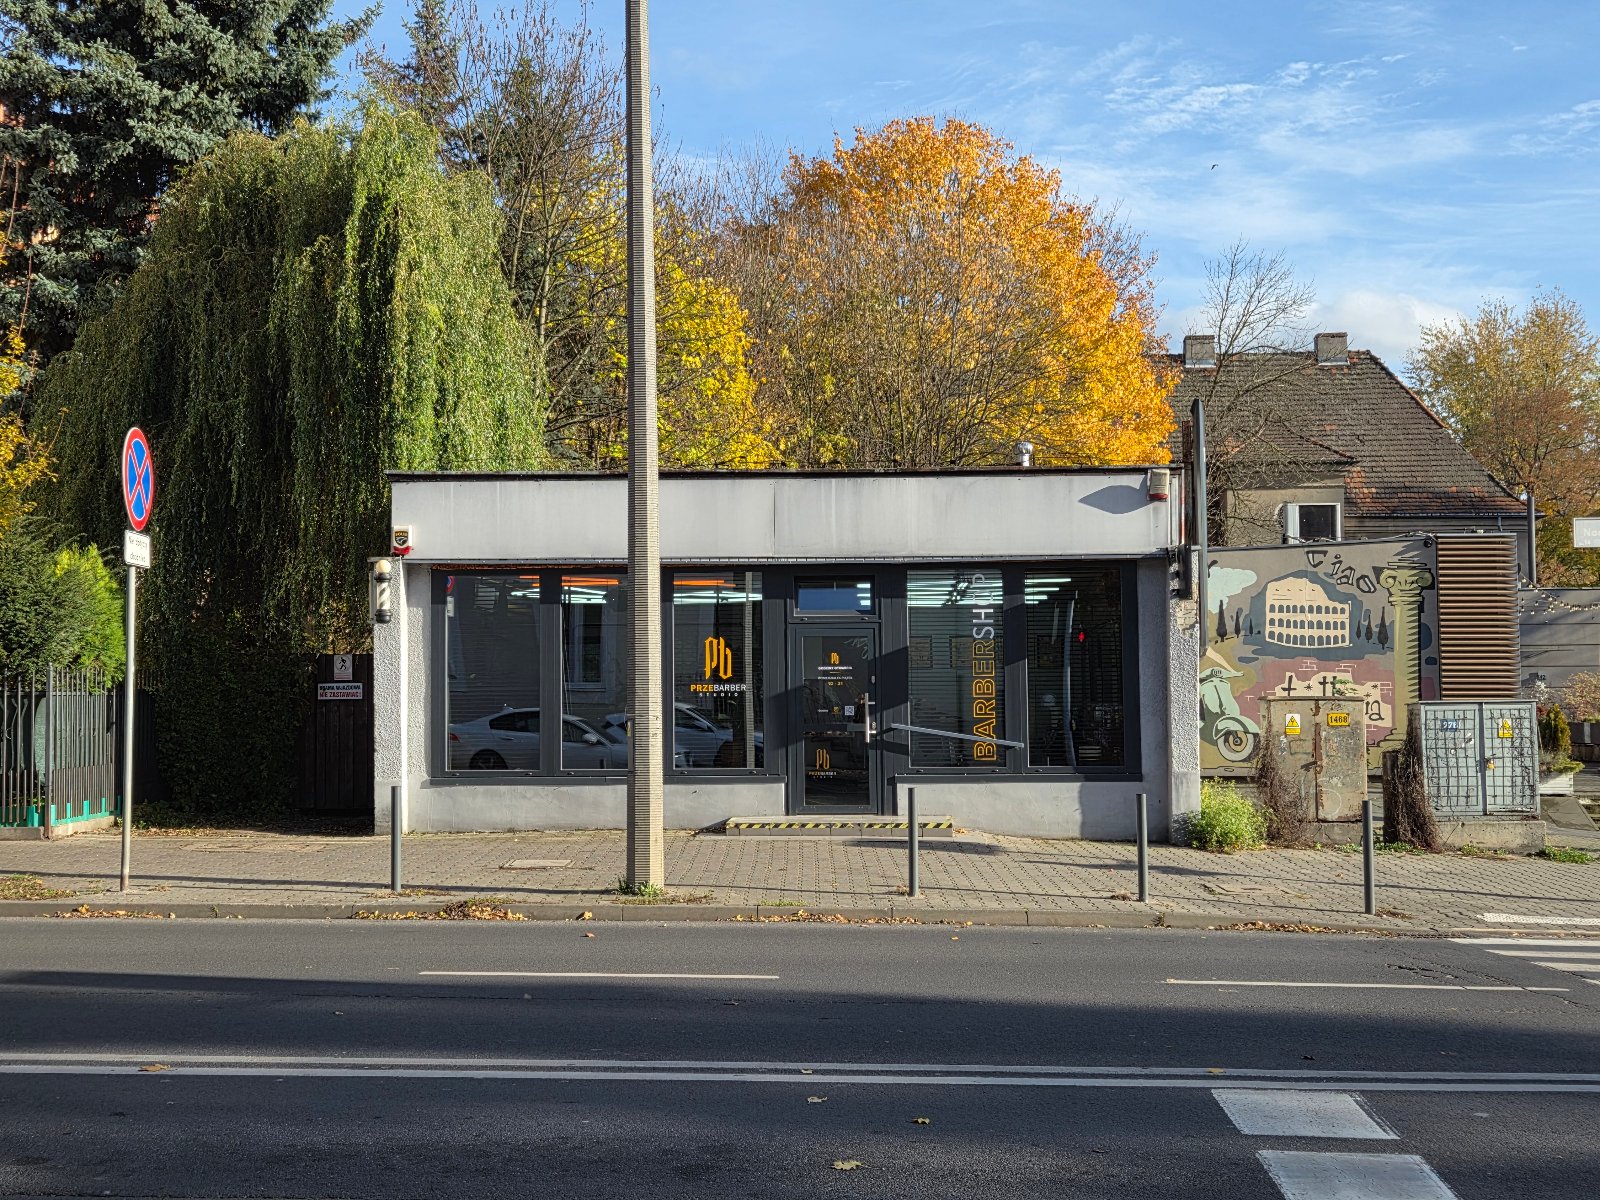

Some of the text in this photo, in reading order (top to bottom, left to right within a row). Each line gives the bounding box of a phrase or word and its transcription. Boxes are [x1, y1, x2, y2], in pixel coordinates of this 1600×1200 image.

[1305, 550, 1377, 593] Ciao
[690, 684, 746, 692] PRZEBARBER
[973, 574, 996, 761] BARBERSHOP
